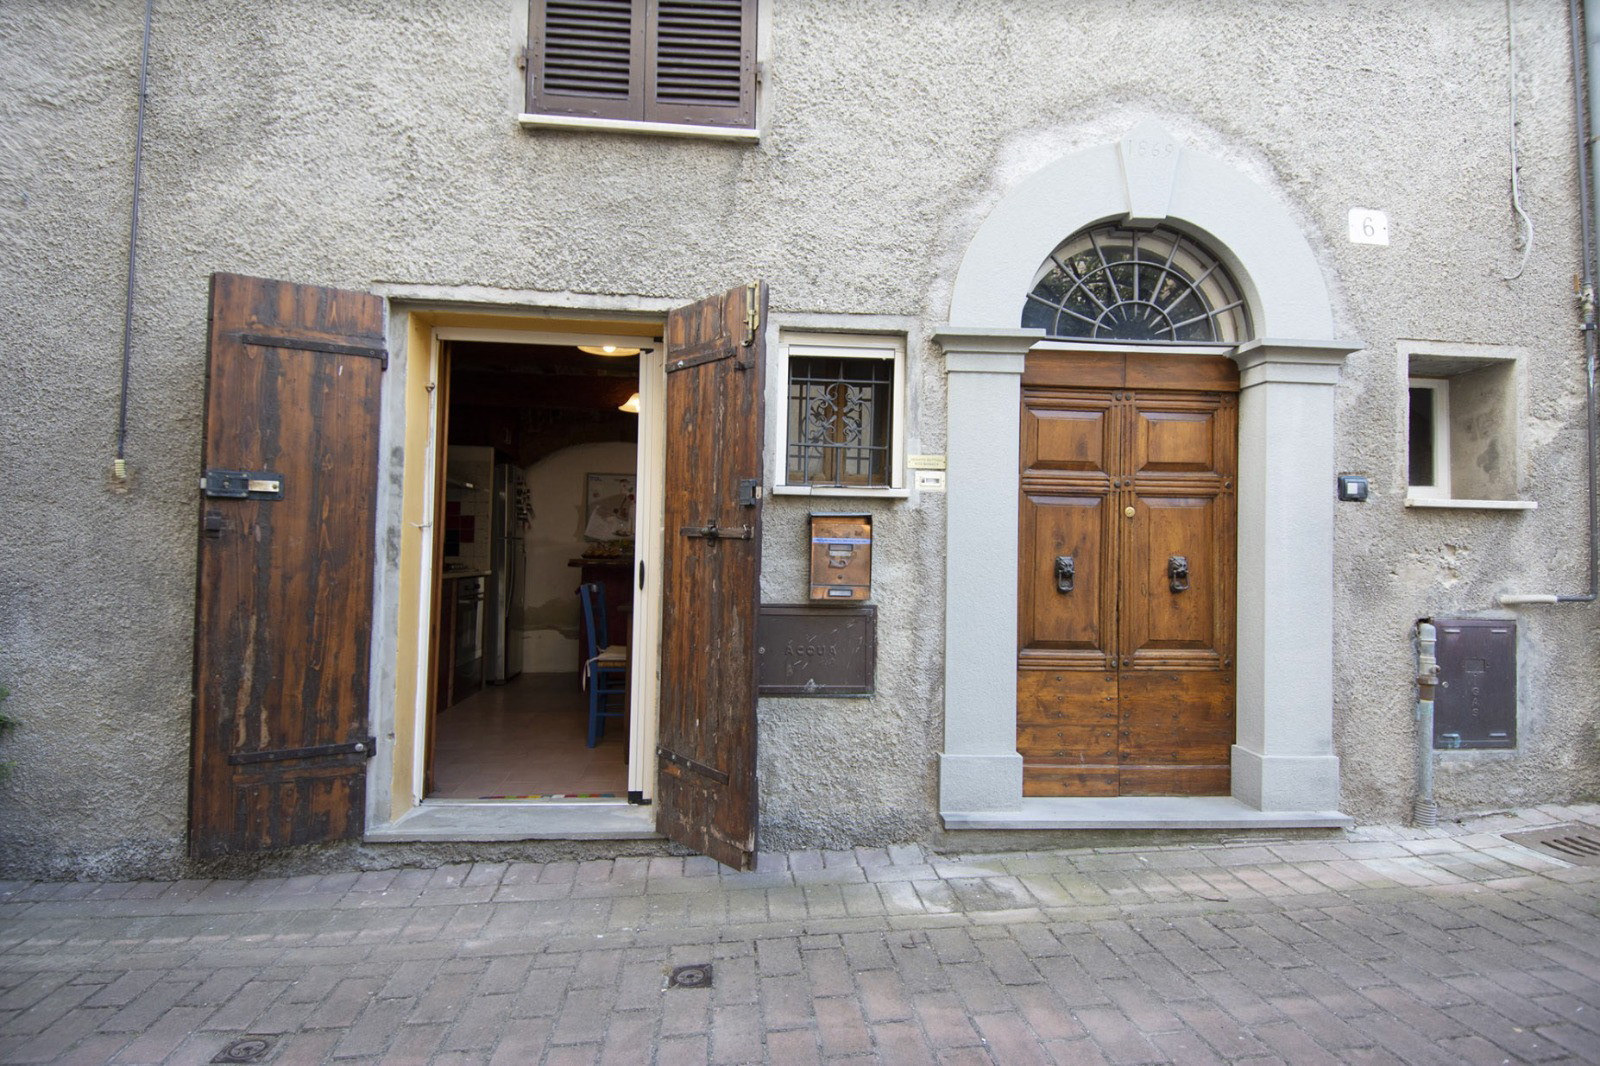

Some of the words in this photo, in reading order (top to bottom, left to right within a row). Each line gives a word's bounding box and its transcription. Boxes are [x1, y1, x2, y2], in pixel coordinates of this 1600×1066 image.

[1362, 216, 1375, 238] 6
[784, 644, 838, 658] ACQUA
[1471, 686, 1480, 718] GAS
